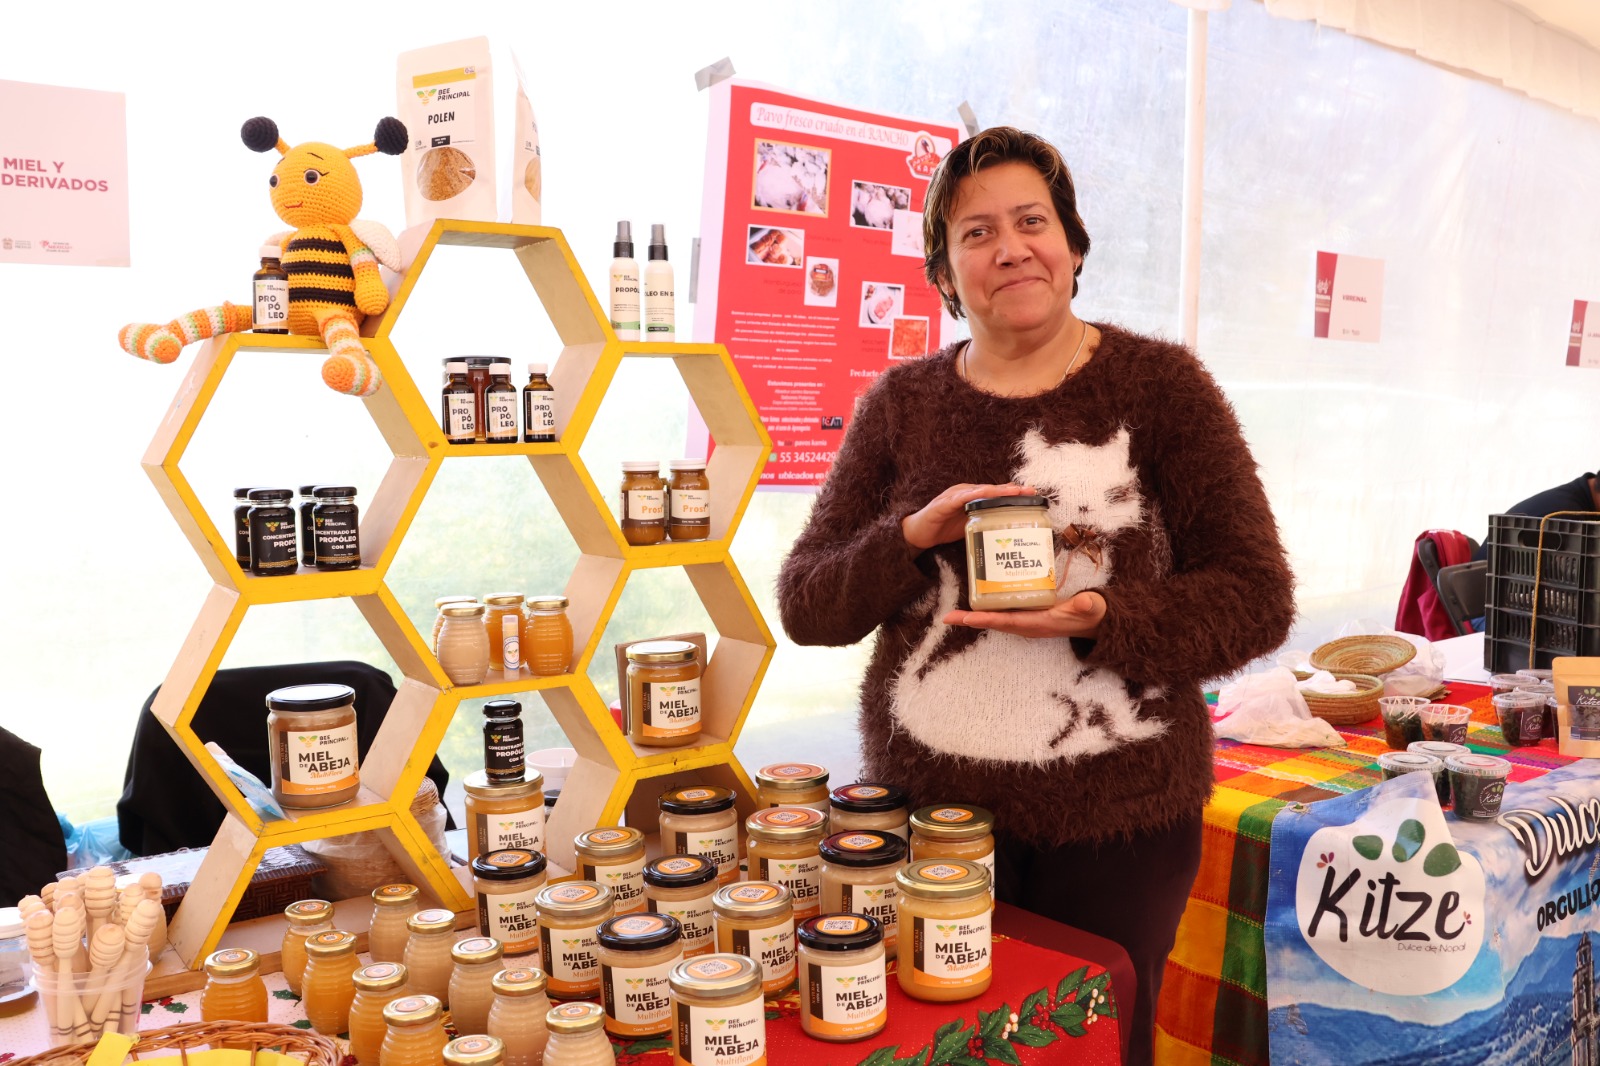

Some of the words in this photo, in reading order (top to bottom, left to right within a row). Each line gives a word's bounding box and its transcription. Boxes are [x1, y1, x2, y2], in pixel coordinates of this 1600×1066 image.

[437, 91, 471, 101] PRINCIPAL
[427, 111, 455, 125] POLEN
[756, 106, 783, 124] Pavo
[783, 111, 813, 130] fresco
[815, 118, 844, 135] criado
[846, 126, 856, 137] en
[858, 121, 867, 138] el
[867, 126, 909, 146] RANCHO
[3, 157, 47, 173] MIEL
[52, 161, 65, 174] Y
[1, 173, 109, 192] DERIVADOS
[258, 295, 277, 303] PRO
[268, 302, 281, 311] PÓ
[268, 311, 284, 319] LEO
[461, 414, 472, 422] PÓ
[500, 412, 512, 420] PÓ
[542, 410, 553, 418] PÓ
[500, 420, 515, 428] LEO
[779, 452, 792, 463] 55
[778, 471, 814, 480] ubicados
[319, 534, 357, 543] PROPÓLEO
[995, 551, 1025, 561] MIEL
[1004, 559, 1043, 570] ABEJA
[1005, 569, 1037, 577] Multiflora
[659, 699, 688, 710] MIEL
[667, 705, 699, 719] ABEJA
[319, 737, 346, 746] PRINCIPAL
[298, 750, 334, 763] MIEL
[307, 757, 351, 773] ABEJA
[498, 833, 525, 842] MIEL
[506, 836, 539, 849] ABEJA
[698, 850, 724, 858] MIEL
[714, 853, 736, 865] BEJA
[778, 878, 811, 889] MIEL
[614, 886, 644, 901] ABEJA
[1307, 865, 1466, 943] Kitze
[1537, 879, 1600, 932] ORGULLO
[863, 904, 896, 917] MIEL
[499, 914, 529, 924] MIEL
[507, 918, 537, 932] ABEJ
[680, 924, 714, 940] ABEJA
[958, 925, 986, 936] PRINCIPAL
[761, 946, 788, 960] MIEL
[935, 942, 972, 954] MIEL
[1397, 942, 1423, 952] Dulce
[1424, 943, 1437, 953] de
[1438, 943, 1467, 953] Nopal
[562, 951, 594, 962] MIEL
[944, 947, 988, 965] ABEJA
[571, 958, 598, 970] ABE
[625, 991, 659, 1003] MIEL
[835, 990, 869, 1002] MIEL
[635, 997, 670, 1012] ABEJ
[845, 993, 884, 1012] ABEJA
[846, 1007, 880, 1020] Multiflora
[728, 1019, 757, 1030] PRINCIPAL
[704, 1034, 741, 1046] MIEL
[714, 1038, 759, 1057] ABEJA
[715, 1053, 754, 1066] Multiflora
